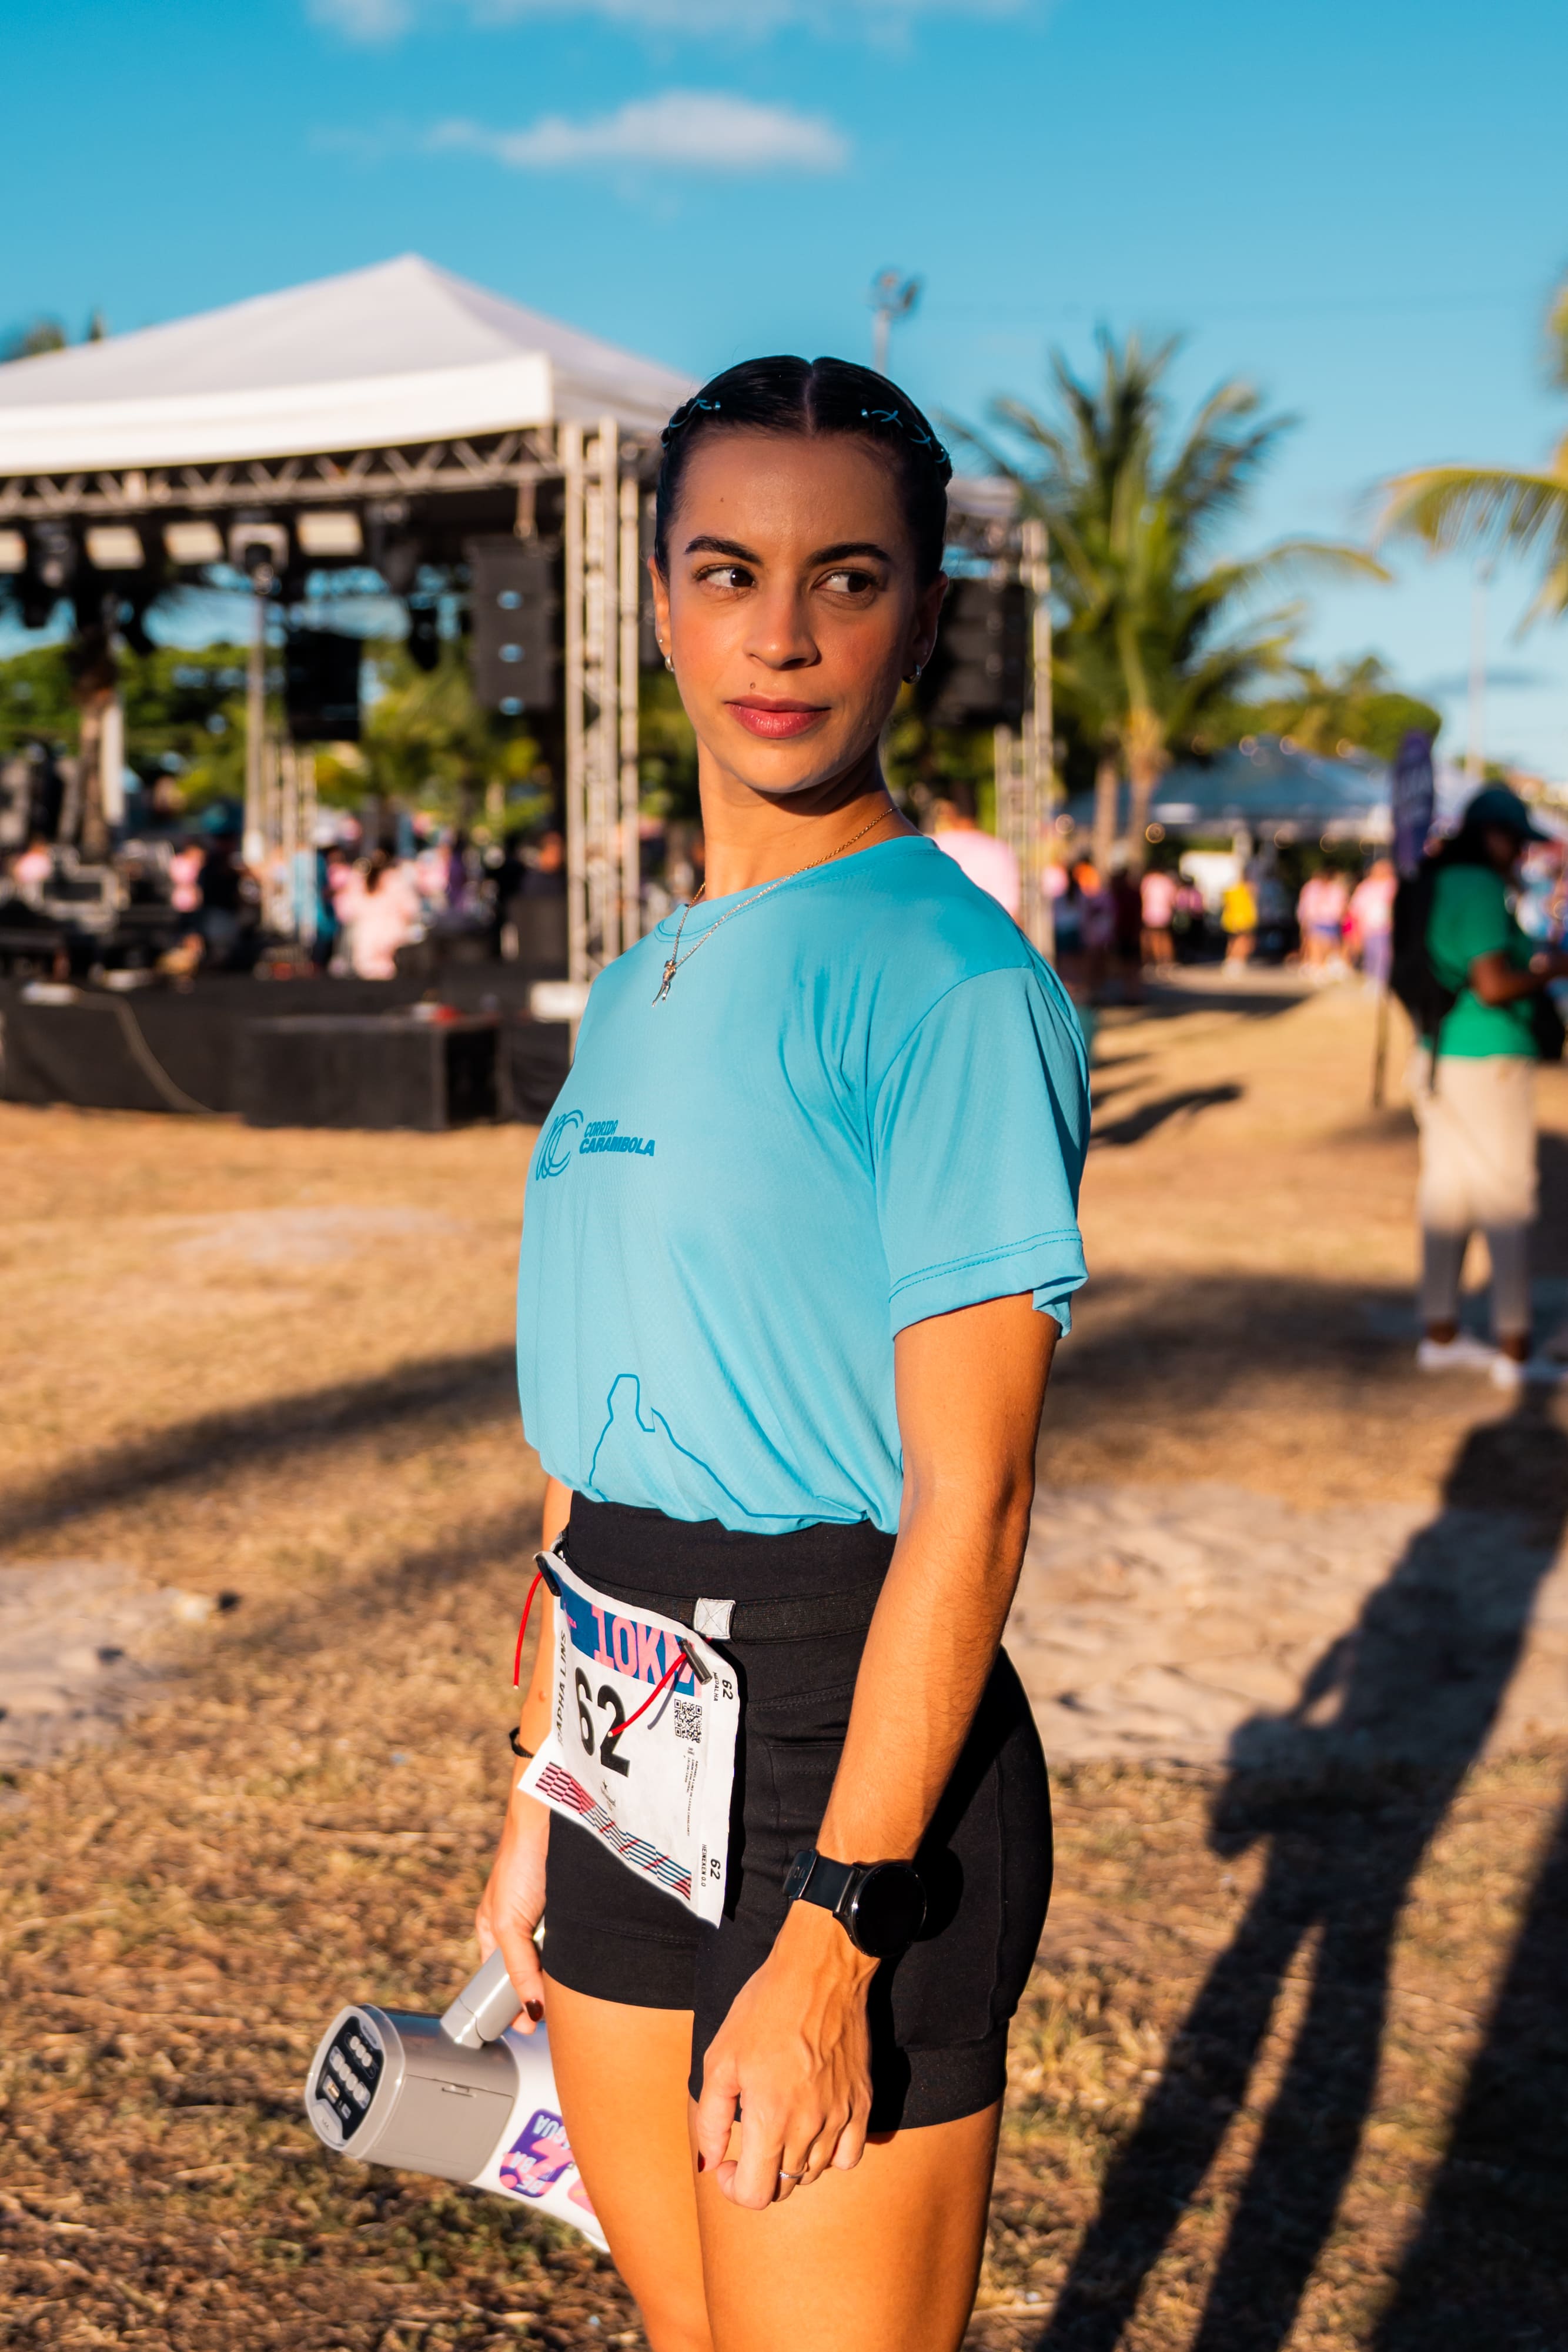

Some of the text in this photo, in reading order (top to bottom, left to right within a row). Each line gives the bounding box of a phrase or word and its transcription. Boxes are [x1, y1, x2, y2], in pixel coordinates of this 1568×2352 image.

[584, 1120, 619, 1138] CORRIDA
[579, 1136, 656, 1157] CARAMBOLA
[722, 1679, 734, 1700] 62
[574, 1666, 631, 1778] 62
[710, 1858, 721, 1880] 62
[509, 2150, 537, 2173] BA
[516, 2174, 545, 2195] BE
